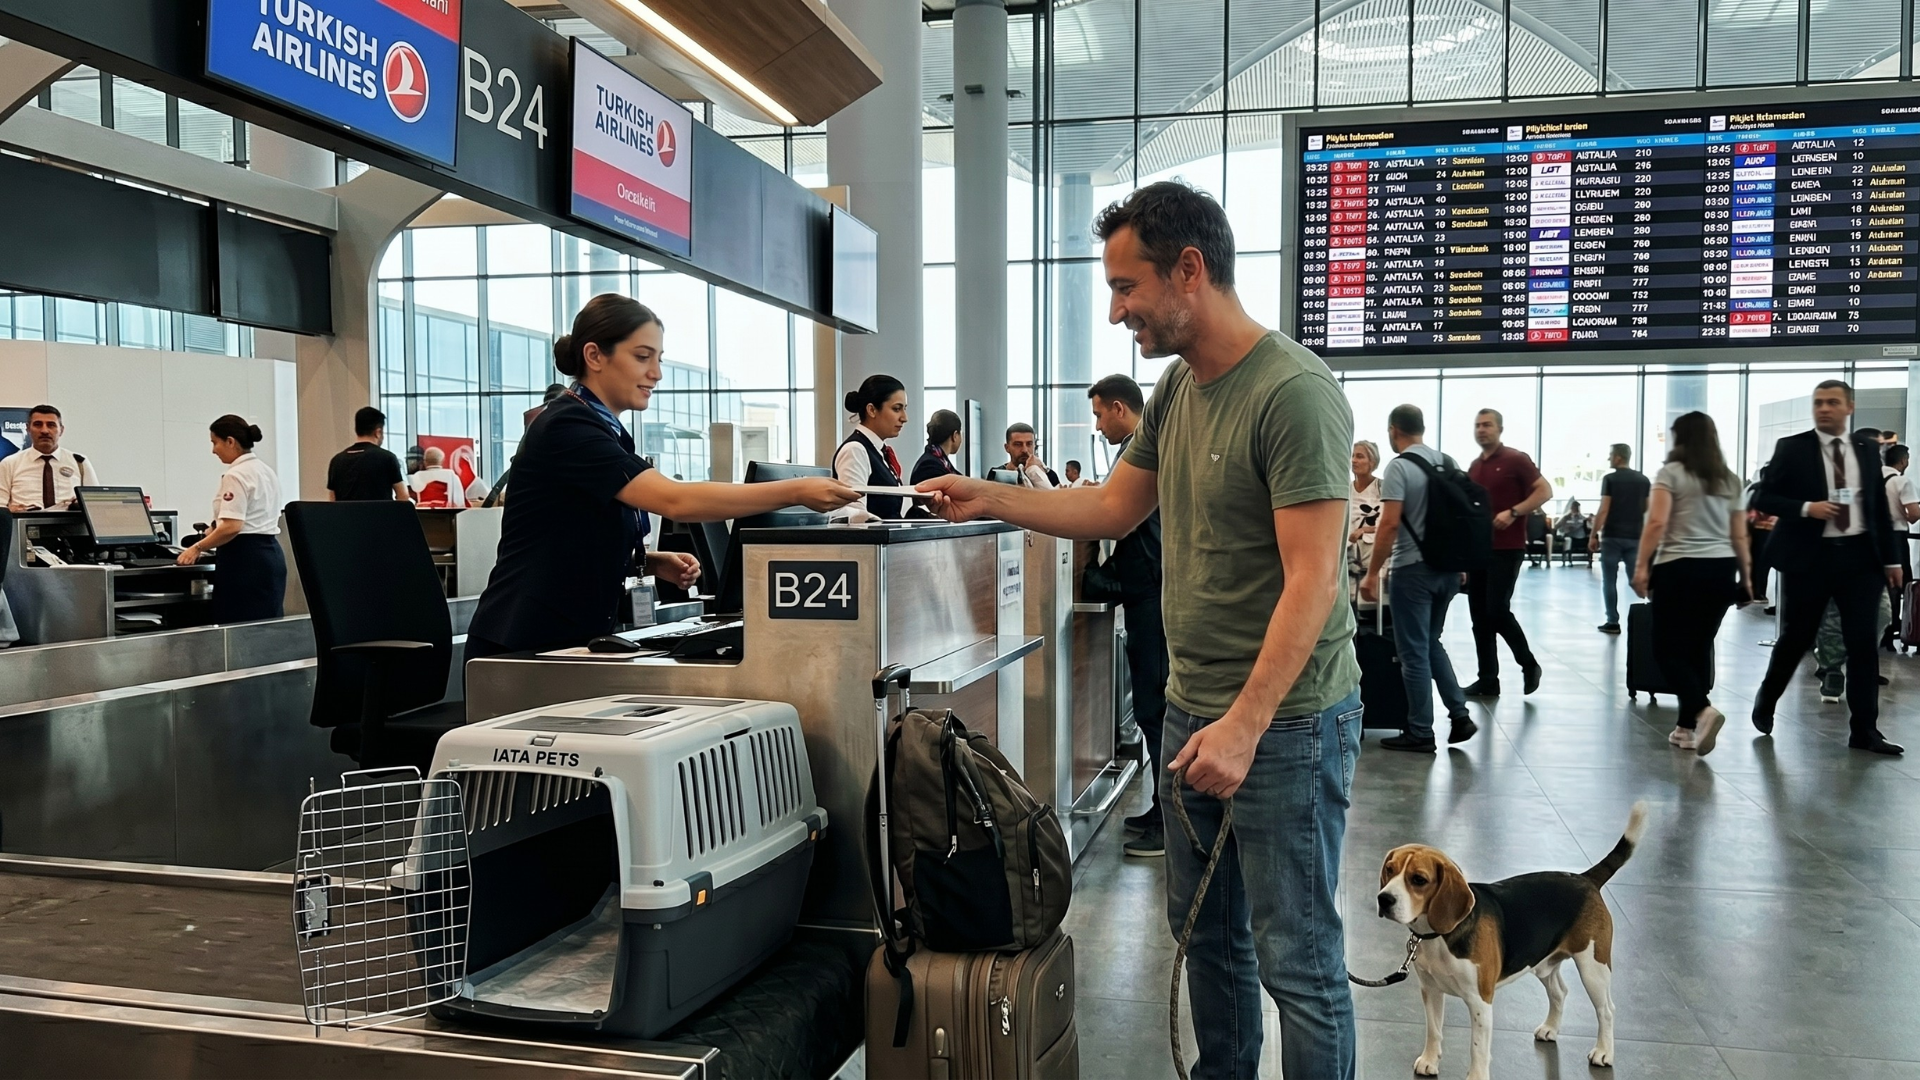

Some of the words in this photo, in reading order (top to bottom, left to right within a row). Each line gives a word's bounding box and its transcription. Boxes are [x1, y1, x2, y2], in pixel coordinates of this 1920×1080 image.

[252, 22, 378, 100] AIRLINES
[464, 46, 548, 150] B24
[596, 84, 654, 134] TURKISH
[595, 111, 654, 157] AIRLINES
[1853, 138, 1864, 147] 12
[1635, 149, 1652, 157] 210
[1853, 152, 1864, 160] 10
[1436, 158, 1447, 166] 12
[1852, 166, 1864, 174] 22
[1635, 174, 1652, 183] 220
[1852, 179, 1863, 187] 12
[1634, 188, 1651, 196] 220
[1851, 192, 1862, 200] 13
[1435, 208, 1446, 216] 20
[1435, 234, 1445, 242] 23
[1850, 245, 1861, 253] 11
[1849, 271, 1860, 279] 10
[1632, 278, 1649, 286] 777
[1849, 284, 1860, 293] 10
[1848, 298, 1860, 306] 10
[1848, 311, 1859, 319] 75
[1433, 322, 1443, 330] 17
[1847, 324, 1859, 333] 70
[776, 572, 852, 608] B24
[493, 748, 530, 764] IATA
[535, 751, 580, 767] PETS
